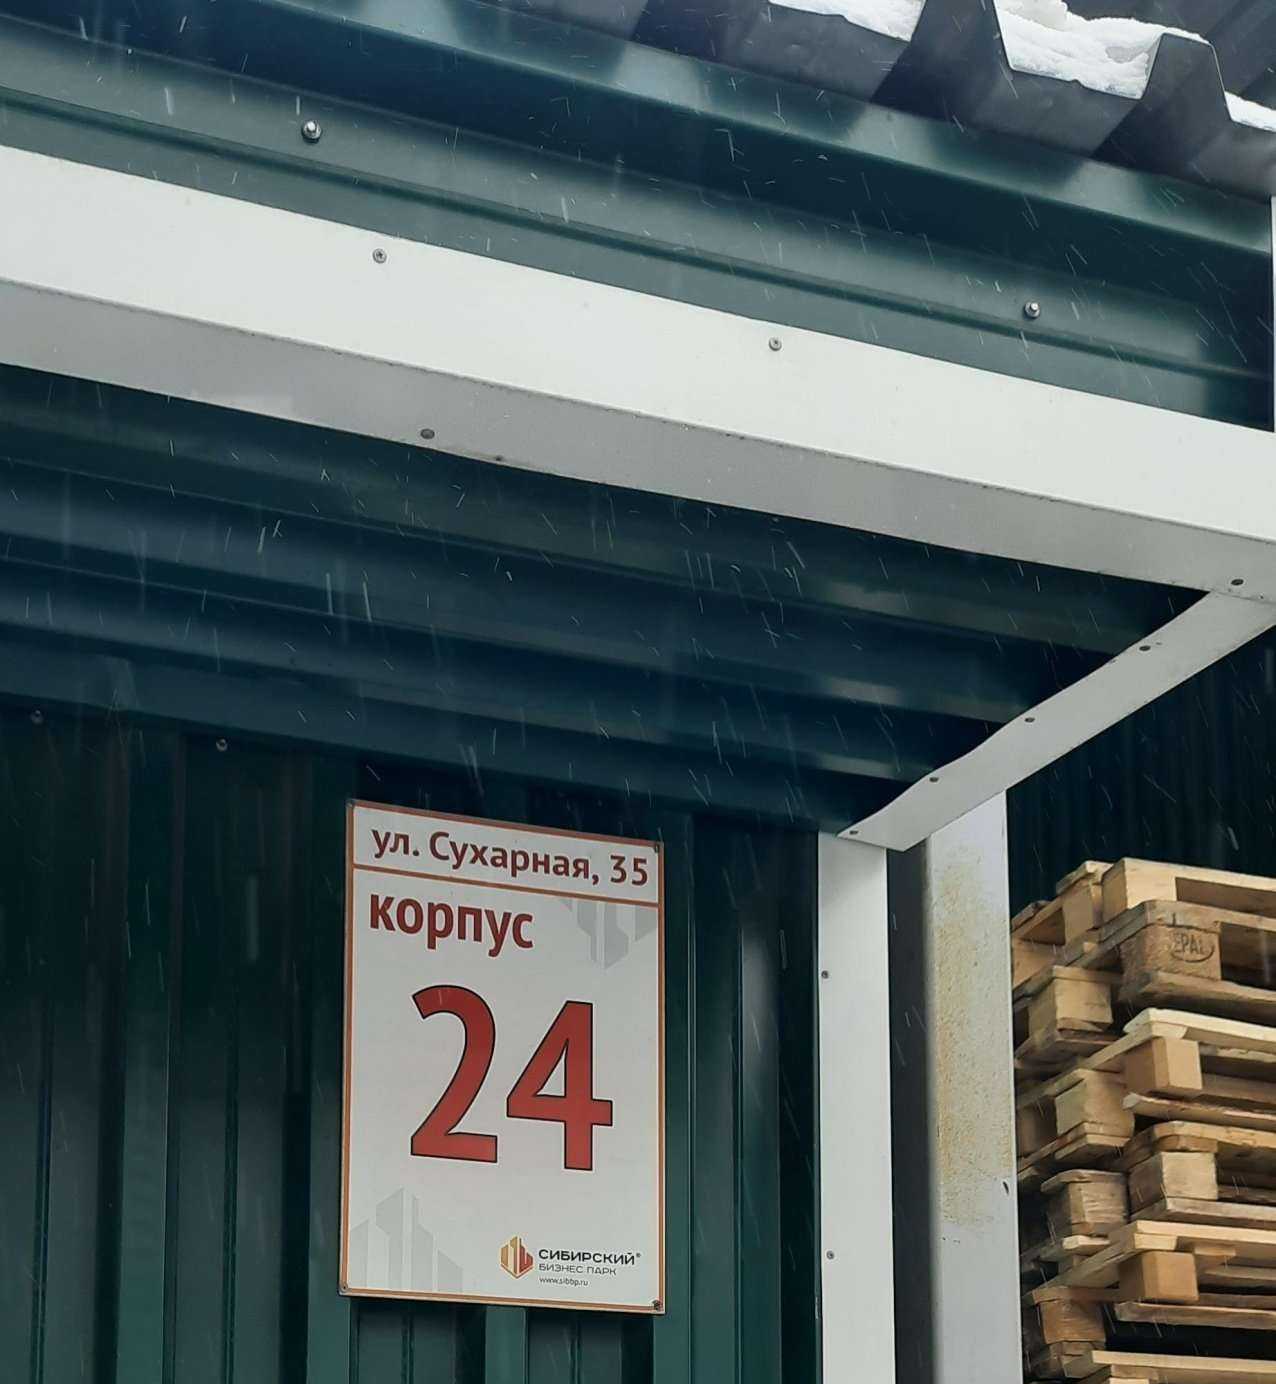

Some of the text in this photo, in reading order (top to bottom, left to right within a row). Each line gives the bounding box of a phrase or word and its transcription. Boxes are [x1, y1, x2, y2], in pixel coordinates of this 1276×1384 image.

[371, 829, 648, 886] ул. Сухарная, 35
[369, 893, 534, 958] корпус
[410, 984, 613, 1171] 24
[539, 1263, 617, 1276] БИЗНЕС ПАРК
